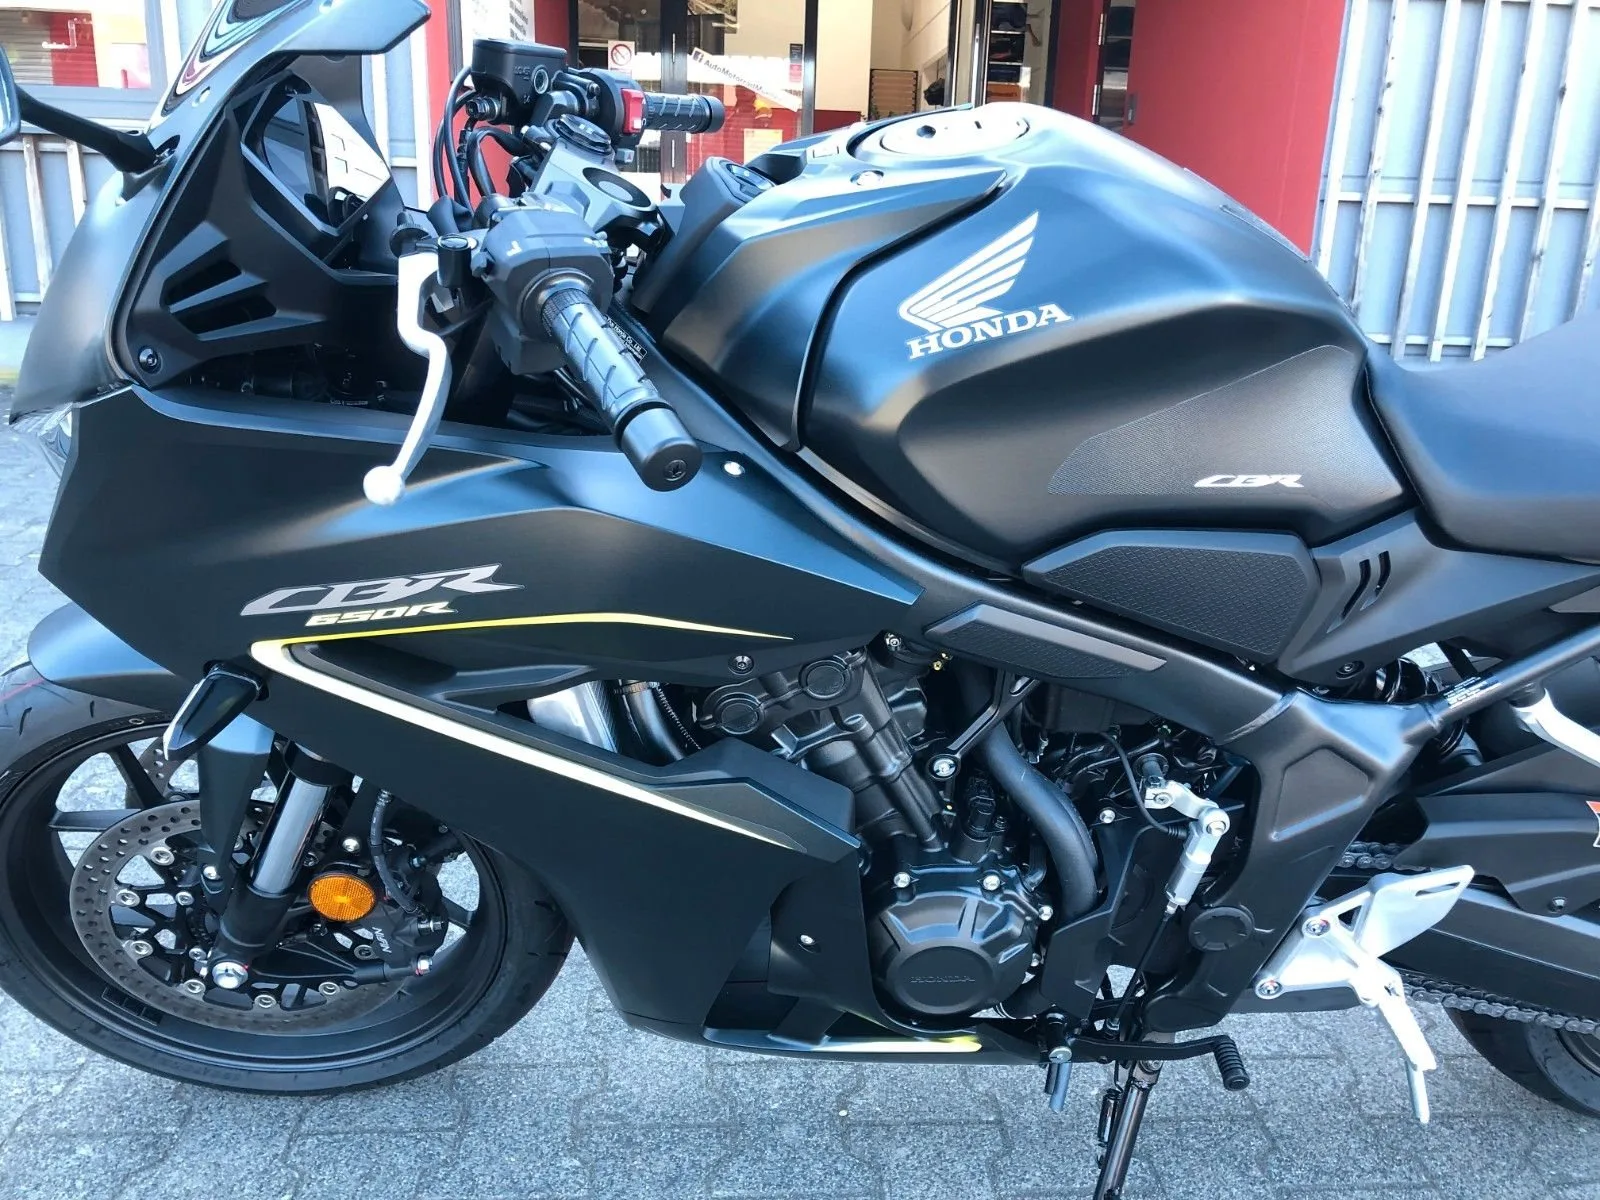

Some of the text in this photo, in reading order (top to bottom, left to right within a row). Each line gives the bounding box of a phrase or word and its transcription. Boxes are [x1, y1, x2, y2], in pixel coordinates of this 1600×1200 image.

[906, 303, 1074, 360] HONDA
[1194, 474, 1305, 488] CBR
[240, 563, 525, 616] CBR
[304, 601, 458, 627] 650R
[909, 975, 976, 984] HONDA
